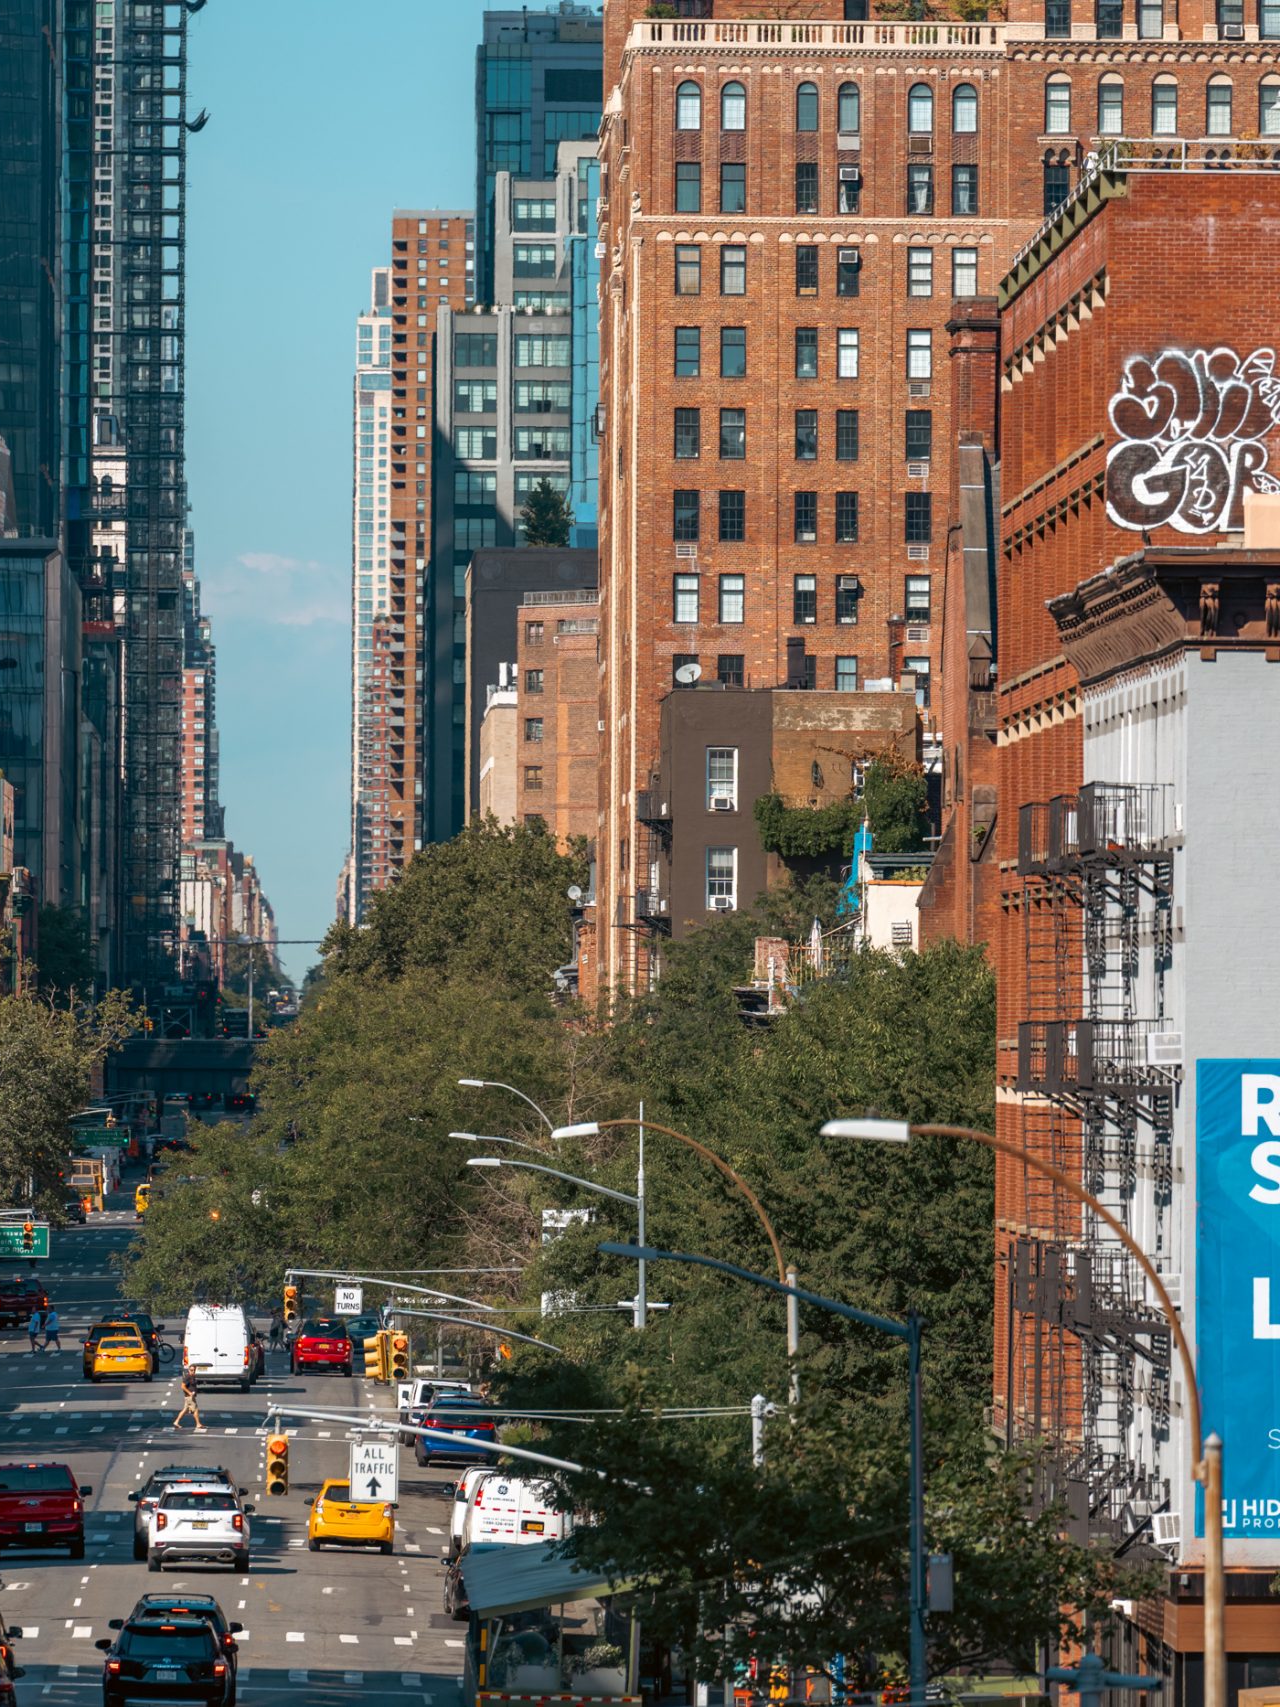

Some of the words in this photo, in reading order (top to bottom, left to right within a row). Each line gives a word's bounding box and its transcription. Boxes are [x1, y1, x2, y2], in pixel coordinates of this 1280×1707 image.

[343, 1292, 355, 1300] NO
[336, 1302, 360, 1310] TURNS
[364, 1448, 385, 1460] ALL
[354, 1462, 394, 1475] TRAFFIC
[1242, 1519, 1280, 1528] PRO
